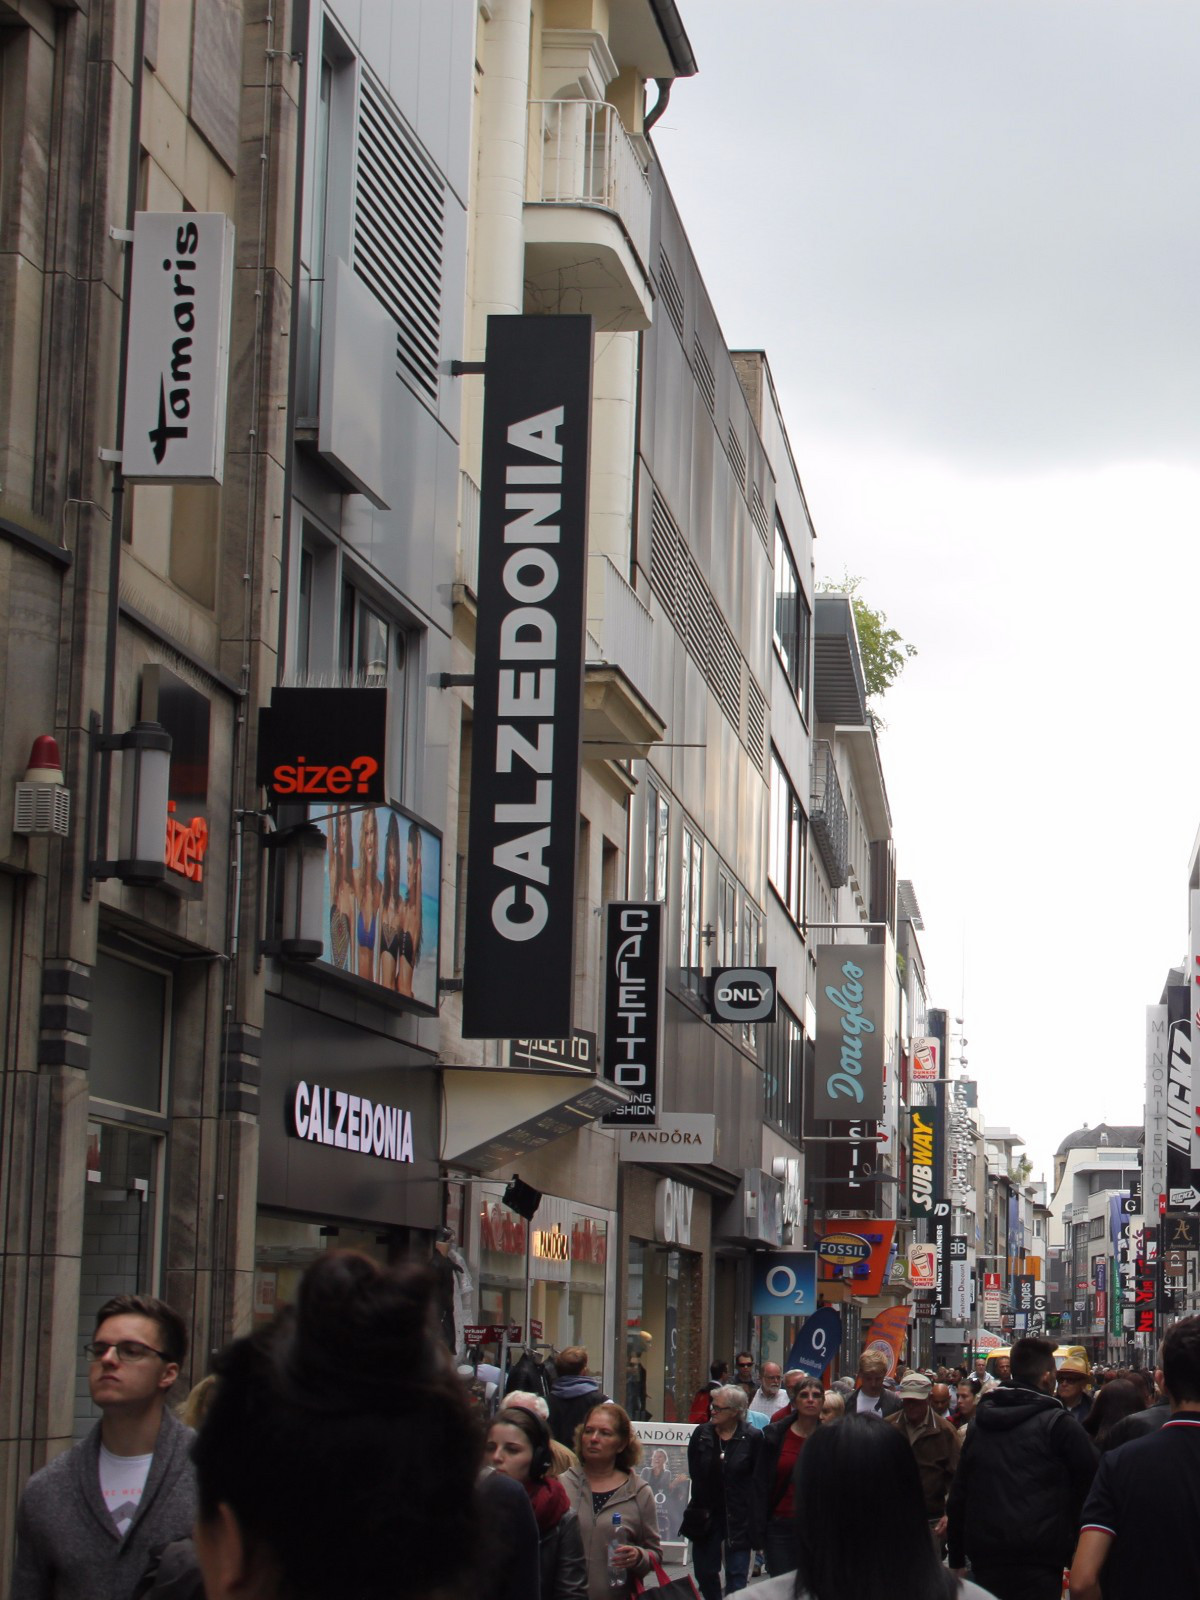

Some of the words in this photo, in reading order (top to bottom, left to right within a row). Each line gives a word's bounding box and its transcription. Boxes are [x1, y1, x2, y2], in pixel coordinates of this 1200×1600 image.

[491, 405, 565, 942] CALZEDONIA
[273, 756, 378, 795] size?
[614, 909, 649, 1087] CALETTO
[717, 987, 770, 1002] ONLY
[827, 960, 875, 1103] Douglas
[294, 1080, 414, 1163] CALZEDONIA
[911, 1112, 933, 1212] SUBWAY
[819, 1243, 866, 1257] FOSSIL
